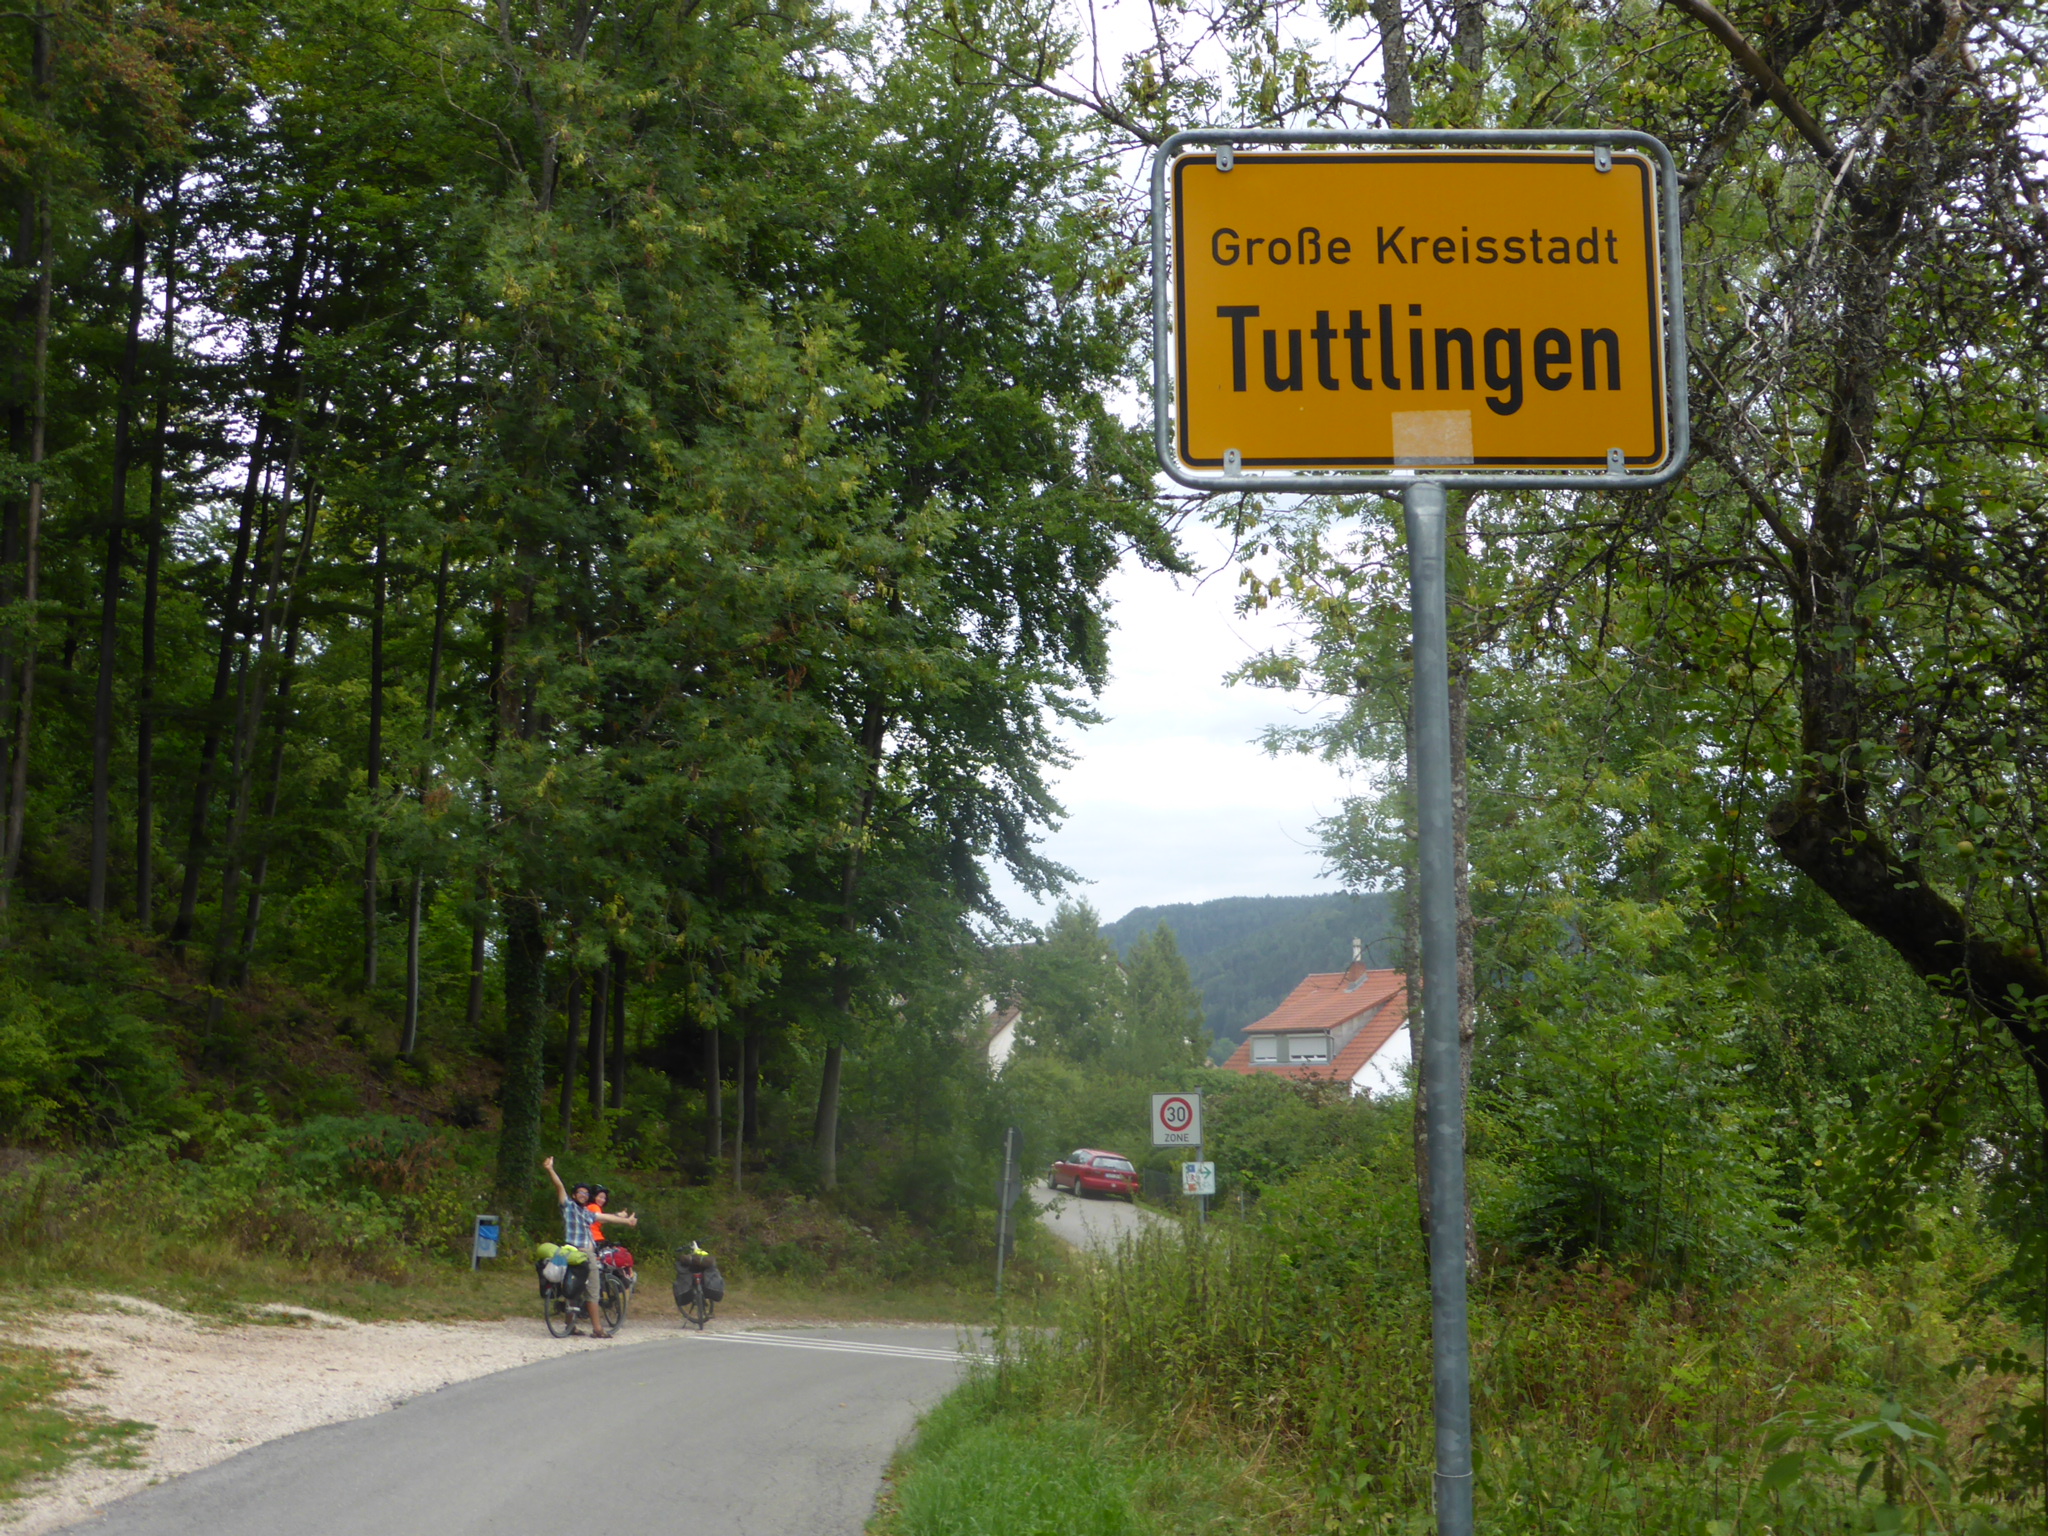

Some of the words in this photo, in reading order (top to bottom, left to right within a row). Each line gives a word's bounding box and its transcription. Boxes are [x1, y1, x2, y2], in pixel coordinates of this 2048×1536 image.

[1211, 226, 1352, 266] Große
[1376, 225, 1619, 265] Kreisstadt
[1216, 303, 1622, 416] Tuttlingen
[1166, 1106, 1186, 1122] 30
[1164, 1133, 1189, 1143] ZONE
